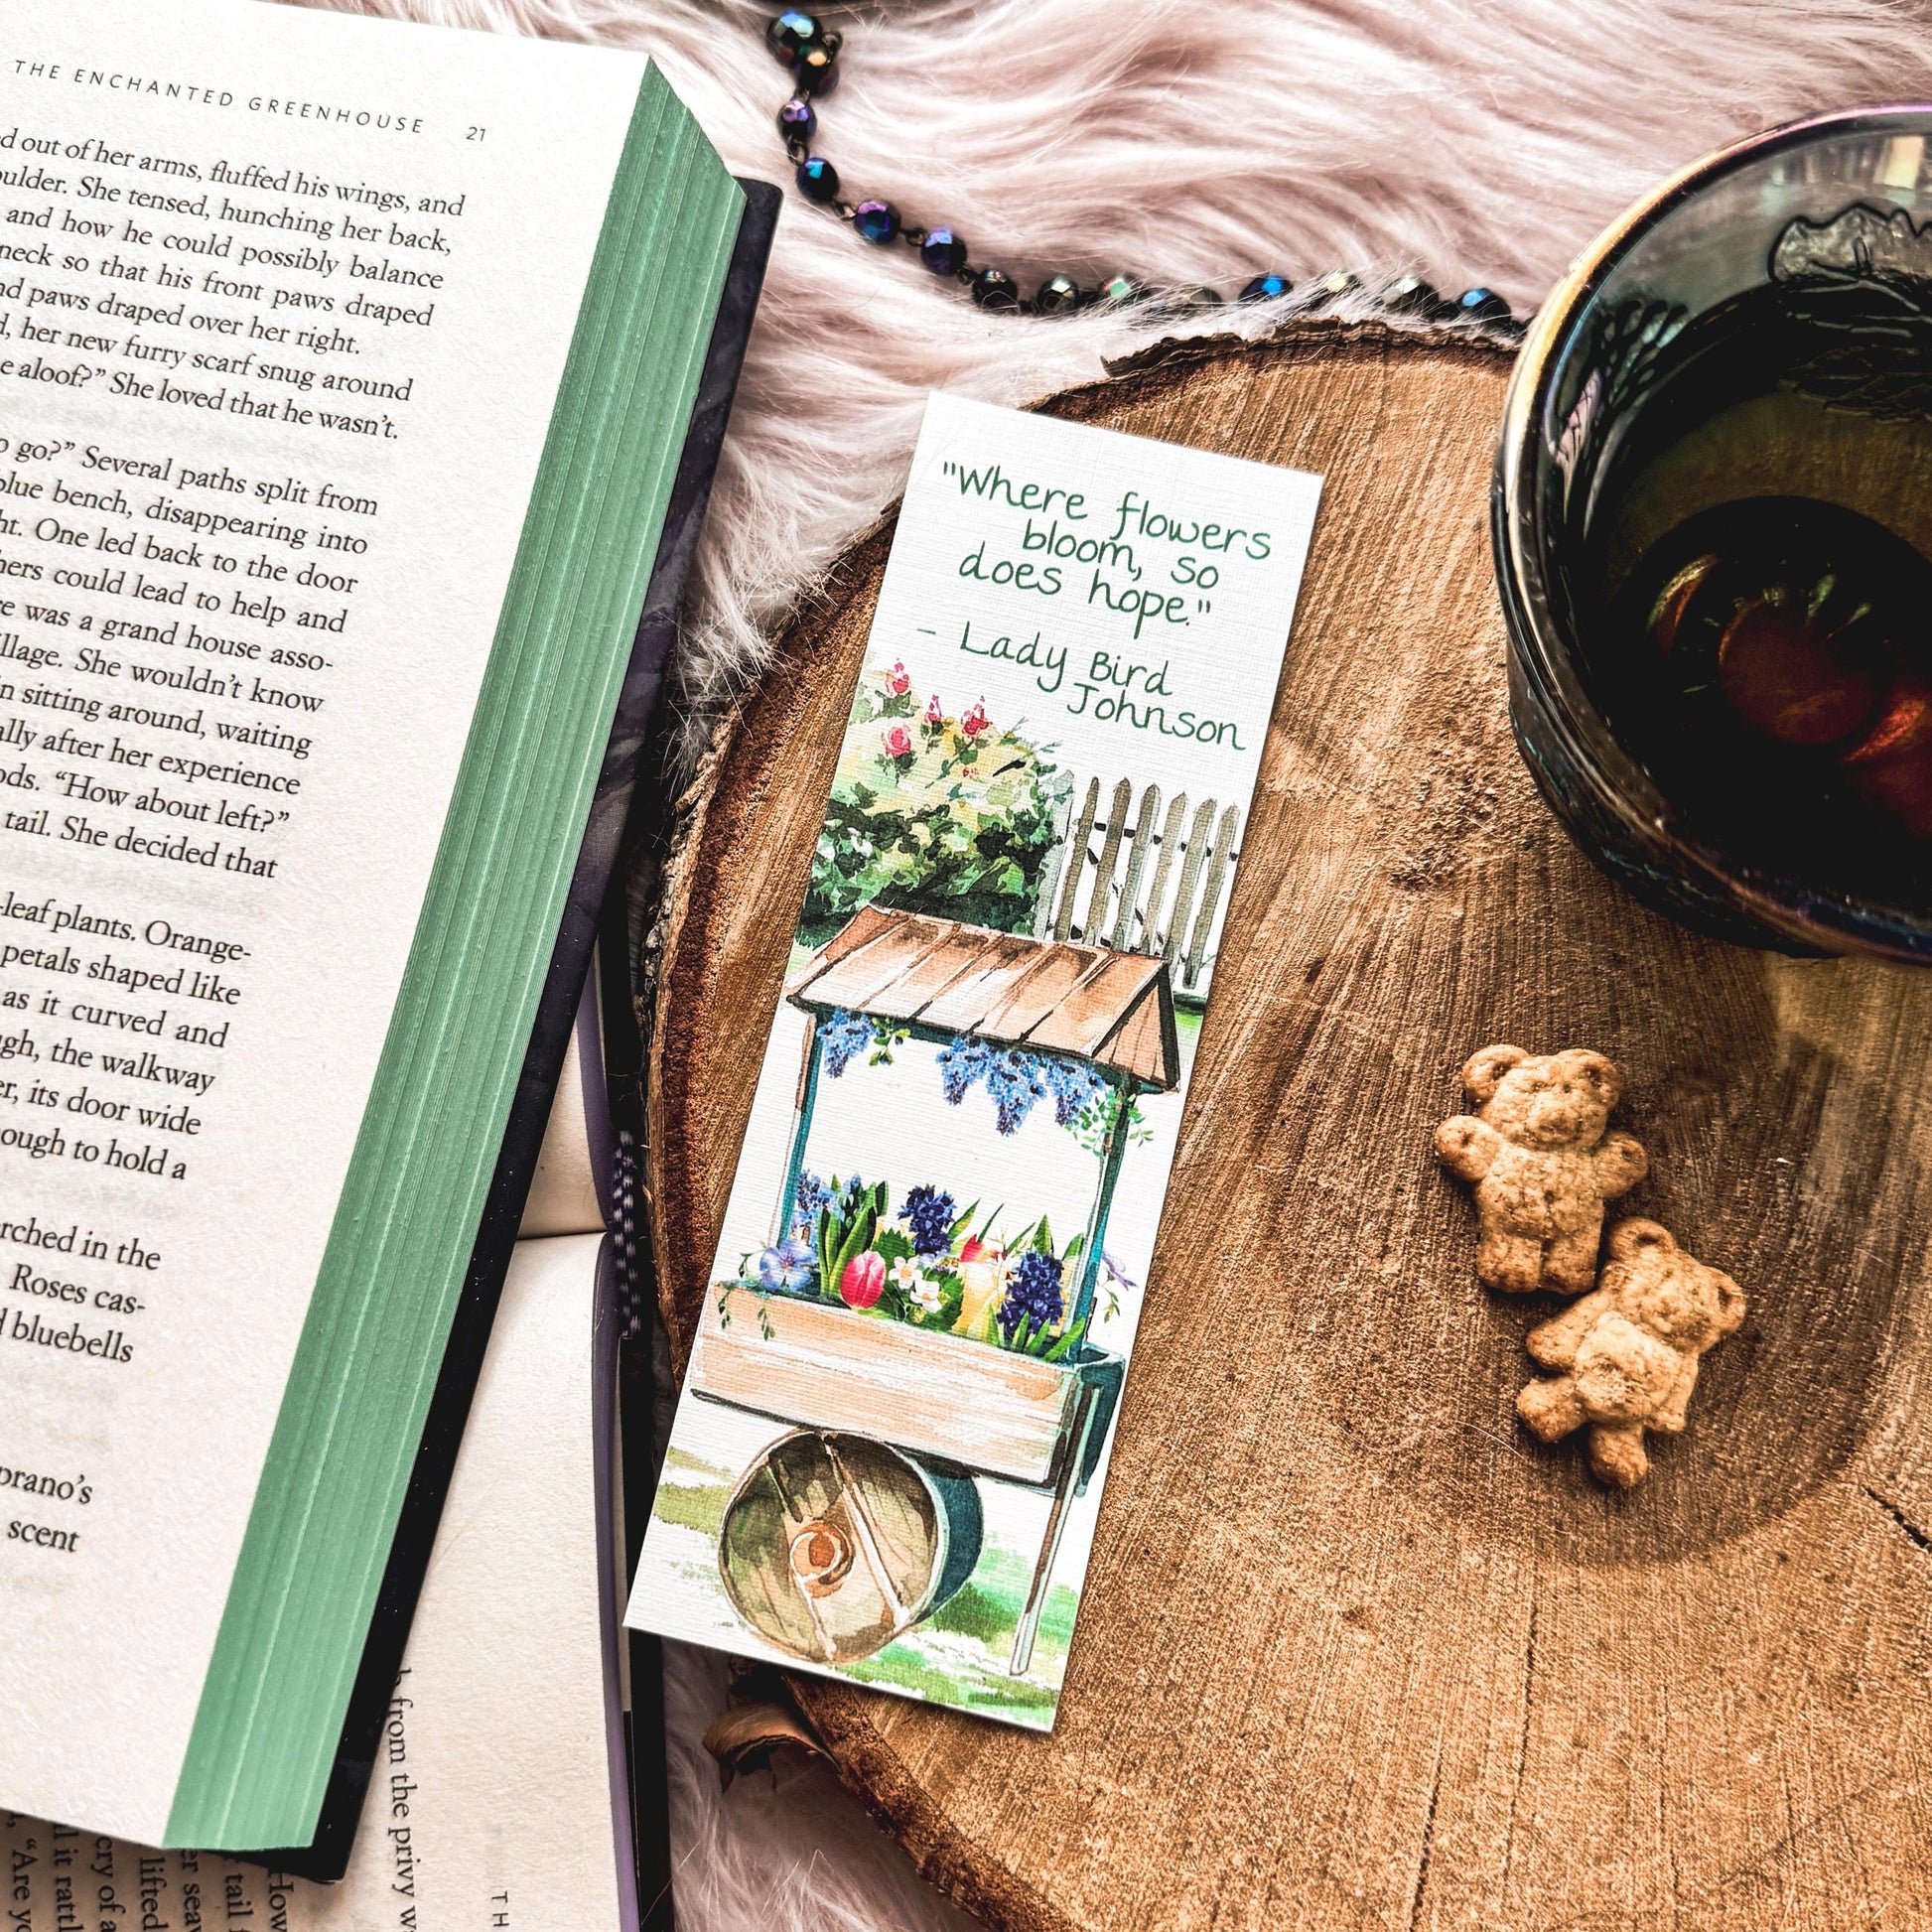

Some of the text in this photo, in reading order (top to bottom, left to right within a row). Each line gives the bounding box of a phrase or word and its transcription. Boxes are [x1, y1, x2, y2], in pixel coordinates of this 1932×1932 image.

[15, 59, 486, 142] THE ENCHANTED GREENHOUSE 21
[0, 165, 452, 257] ulder. She tensed, hunching her back,
[20, 136, 63, 157] out
[64, 138, 100, 162] of
[95, 146, 137, 169] her
[138, 155, 204, 185] arms,
[207, 159, 292, 194] fluffed
[292, 171, 331, 200] his
[335, 182, 411, 214] wings,
[417, 194, 467, 217] and
[5, 206, 445, 290] and how he could possibly balance
[25, 287, 91, 311] paws
[95, 292, 187, 327] draped
[188, 314, 244, 337] over
[247, 315, 291, 344] her
[295, 326, 360, 355] right.
[62, 255, 90, 272] so
[98, 254, 150, 283] that
[155, 262, 194, 290] his
[202, 270, 265, 301] front
[269, 289, 336, 312] paws
[343, 293, 436, 328] draped
[19, 316, 63, 345] her
[65, 332, 119, 353] new
[122, 334, 188, 370] furry
[191, 352, 258, 376] scarf
[256, 363, 318, 392] snug
[321, 373, 414, 402] around
[108, 370, 155, 400] She
[156, 377, 227, 411] loved
[228, 390, 280, 420] that
[280, 397, 314, 426] he
[78, 445, 174, 482] Several
[175, 467, 248, 494] paths
[253, 477, 311, 505] split
[315, 483, 378, 516] from
[942, 461, 1272, 561] "Where flowers
[52, 479, 133, 520] bench,
[144, 495, 310, 550] disappearing
[316, 524, 368, 555] into
[33, 517, 89, 548] One
[93, 526, 139, 556] led
[141, 534, 205, 569] back
[211, 553, 238, 574] to
[245, 553, 289, 582] the
[295, 562, 359, 594] door
[1021, 518, 1220, 590] bloom, so
[52, 567, 127, 596] could
[130, 574, 189, 606] lead
[194, 591, 221, 612] to
[228, 590, 287, 628] help
[294, 608, 348, 633] and
[958, 541, 1211, 640] does hope."
[0, 632, 64, 670] llage.
[72, 646, 122, 678] She
[247, 676, 326, 713] know
[24, 604, 71, 627] was
[77, 615, 93, 632] a
[97, 619, 181, 646] grand
[184, 623, 262, 660] house
[268, 647, 334, 672] asso-
[959, 621, 1068, 694] Lady
[1088, 650, 1173, 697] Bird
[20, 682, 104, 723] sitting
[104, 704, 207, 741] around,
[215, 721, 314, 760] waiting
[1066, 681, 1247, 752] Johnson
[40, 727, 105, 759] after
[107, 737, 154, 768] her
[158, 756, 302, 795] experience
[133, 786, 212, 822] about
[2, 809, 279, 879] tail. She decided that
[49, 903, 137, 942] plants.
[144, 919, 252, 965] Orange-
[0, 944, 241, 1006] petals shaped like
[0, 989, 231, 1049] as it curved and
[0, 1028, 216, 1097] gh, the walkway
[26, 1078, 61, 1108] its
[65, 1085, 131, 1122] door
[137, 1103, 202, 1136] wide
[72, 1139, 100, 1163] to
[102, 1138, 170, 1176] hold
[170, 1162, 188, 1180] a
[78, 1230, 108, 1261] in
[115, 1237, 162, 1272] the
[8, 1262, 147, 1315] Roses cas-
[10, 1310, 134, 1364] bluebells
[6, 1519, 80, 1554] scent
[387, 1696, 414, 1765] from
[390, 1772, 419, 1819] the
[53, 1848, 79, 1867] it
[89, 1836, 114, 1878] cry
[387, 1826, 422, 1898] privy
[97, 1884, 127, 1915] of
[139, 1856, 170, 1932] lifted
[224, 1871, 255, 1920] tail
